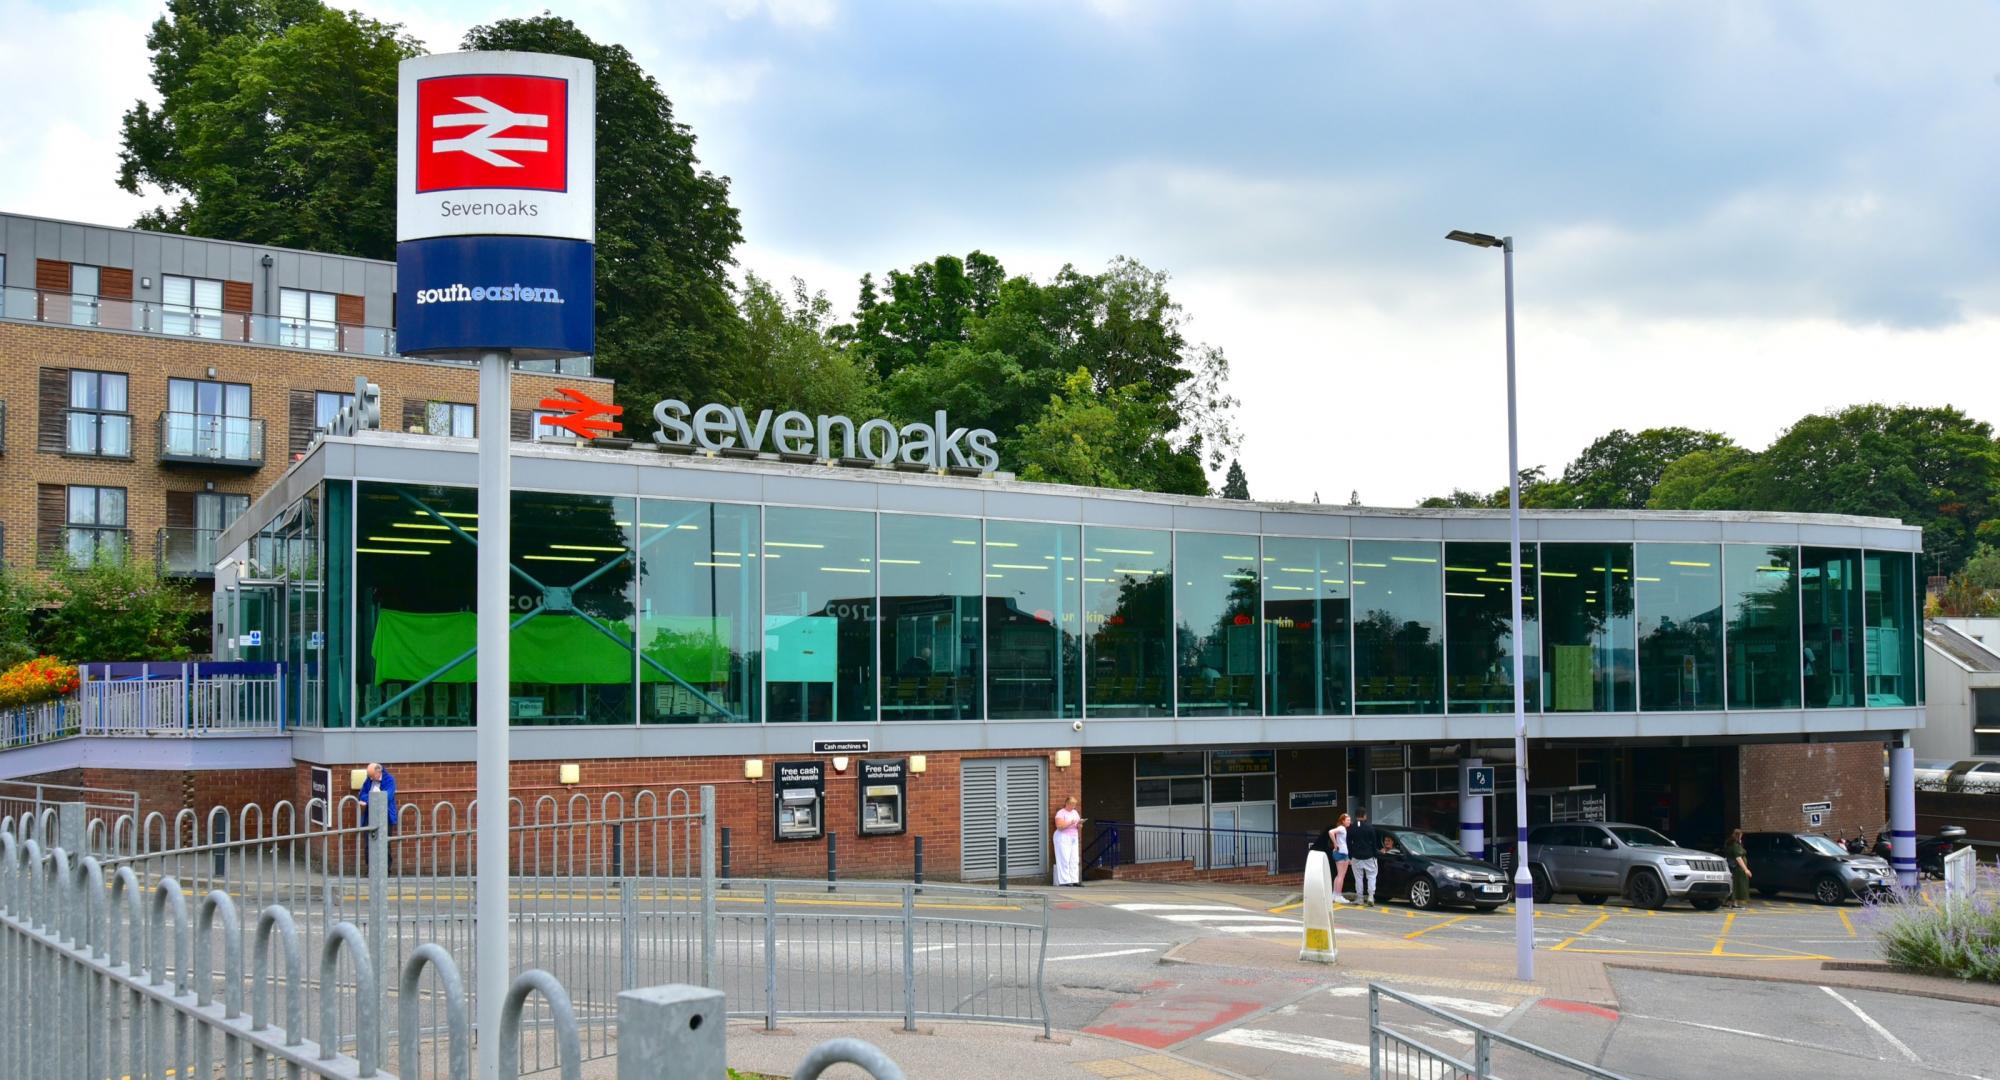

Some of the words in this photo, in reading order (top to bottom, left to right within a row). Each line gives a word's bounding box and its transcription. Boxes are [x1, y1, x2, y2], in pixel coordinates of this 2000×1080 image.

[441, 200, 538, 218] Sevenoaks
[653, 398, 1000, 473] sevenoaks
[781, 767, 798, 775] free
[799, 766, 819, 775] cash
[865, 764, 882, 773] Free
[883, 764, 901, 773] Cash
[781, 774, 819, 782] withdrawals
